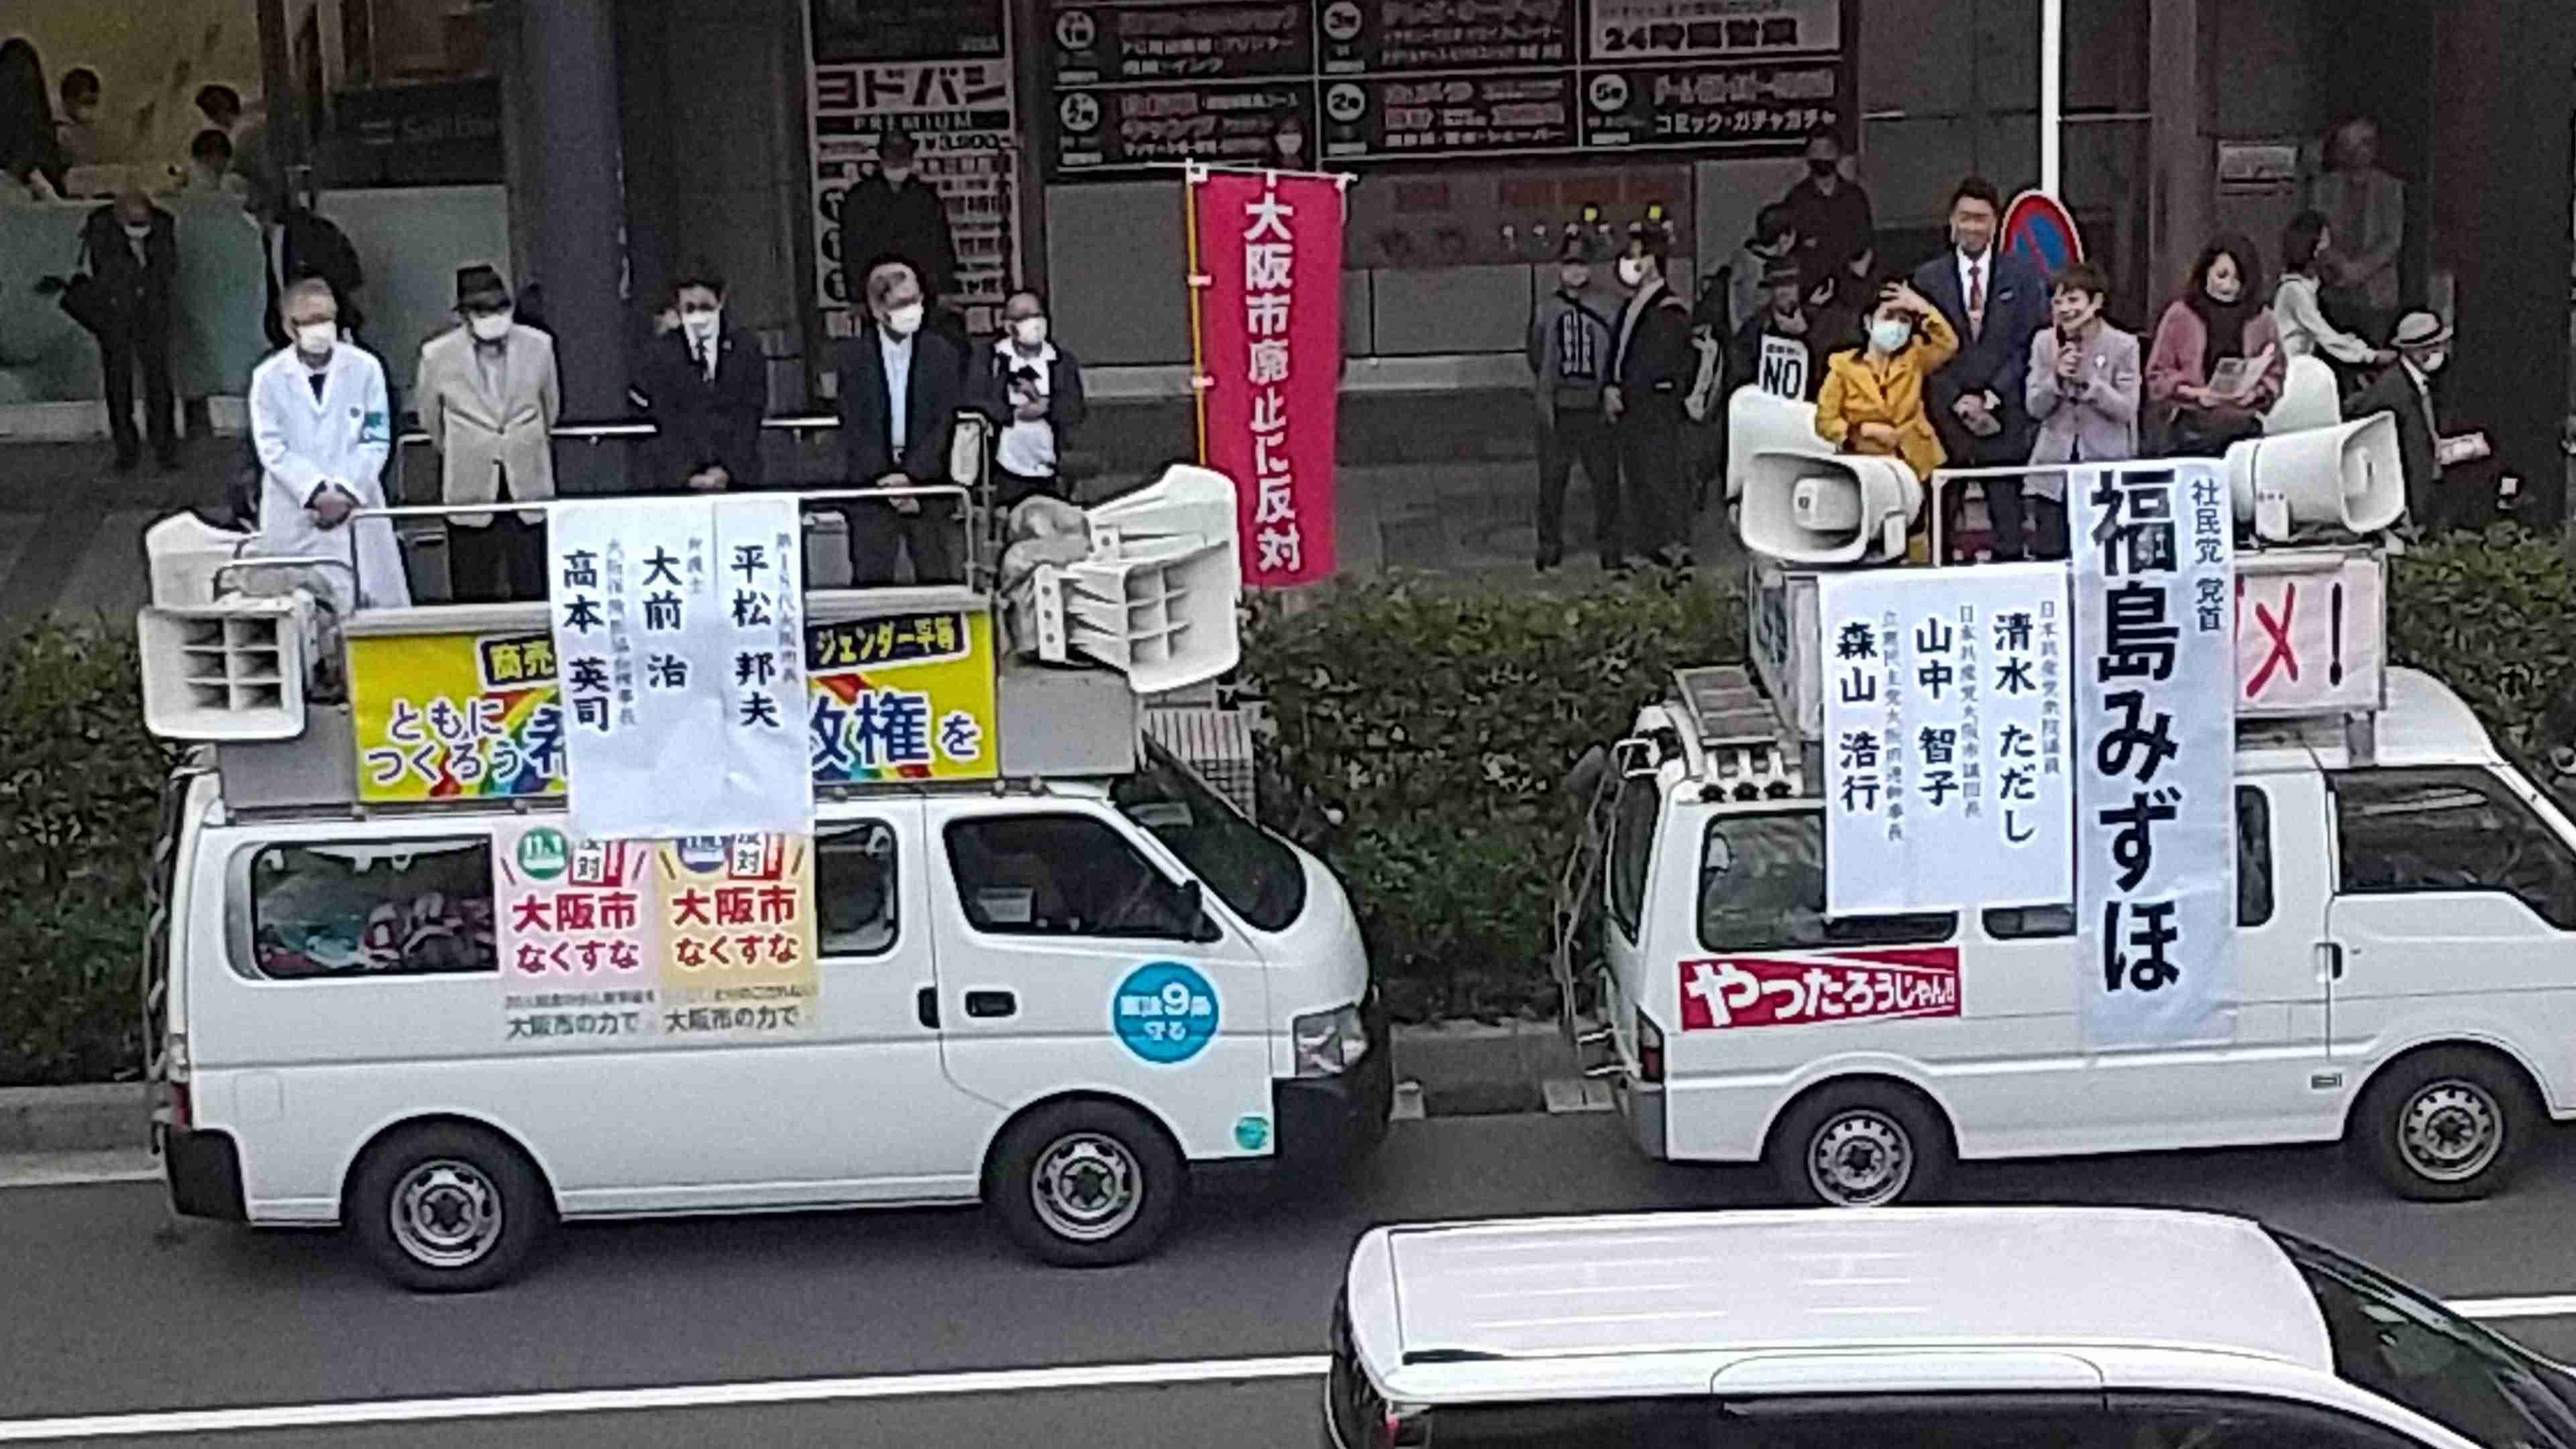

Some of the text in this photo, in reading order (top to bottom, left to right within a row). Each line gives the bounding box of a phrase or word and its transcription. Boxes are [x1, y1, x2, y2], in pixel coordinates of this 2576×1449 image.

[1244, 192, 1301, 572] 大阪市廃止に反対
[1762, 355, 1802, 400] NO
[562, 548, 611, 732] 高本 英司
[641, 545, 688, 688] 大前 治
[731, 544, 780, 728] 平松 邦夫
[2235, 574, 2343, 698] メ!
[368, 739, 519, 782] つくろう
[391, 700, 503, 739] ともに
[1835, 621, 1881, 812] 森山 浩行
[1916, 617, 1960, 806] 山中 智子
[1994, 611, 2038, 843] 清水 ただし
[2090, 468, 2182, 992] 福島みずほ
[513, 892, 638, 932] 大阪市
[516, 941, 639, 973] なくすな
[672, 885, 797, 926] 大阪市
[676, 934, 798, 965] なくすな
